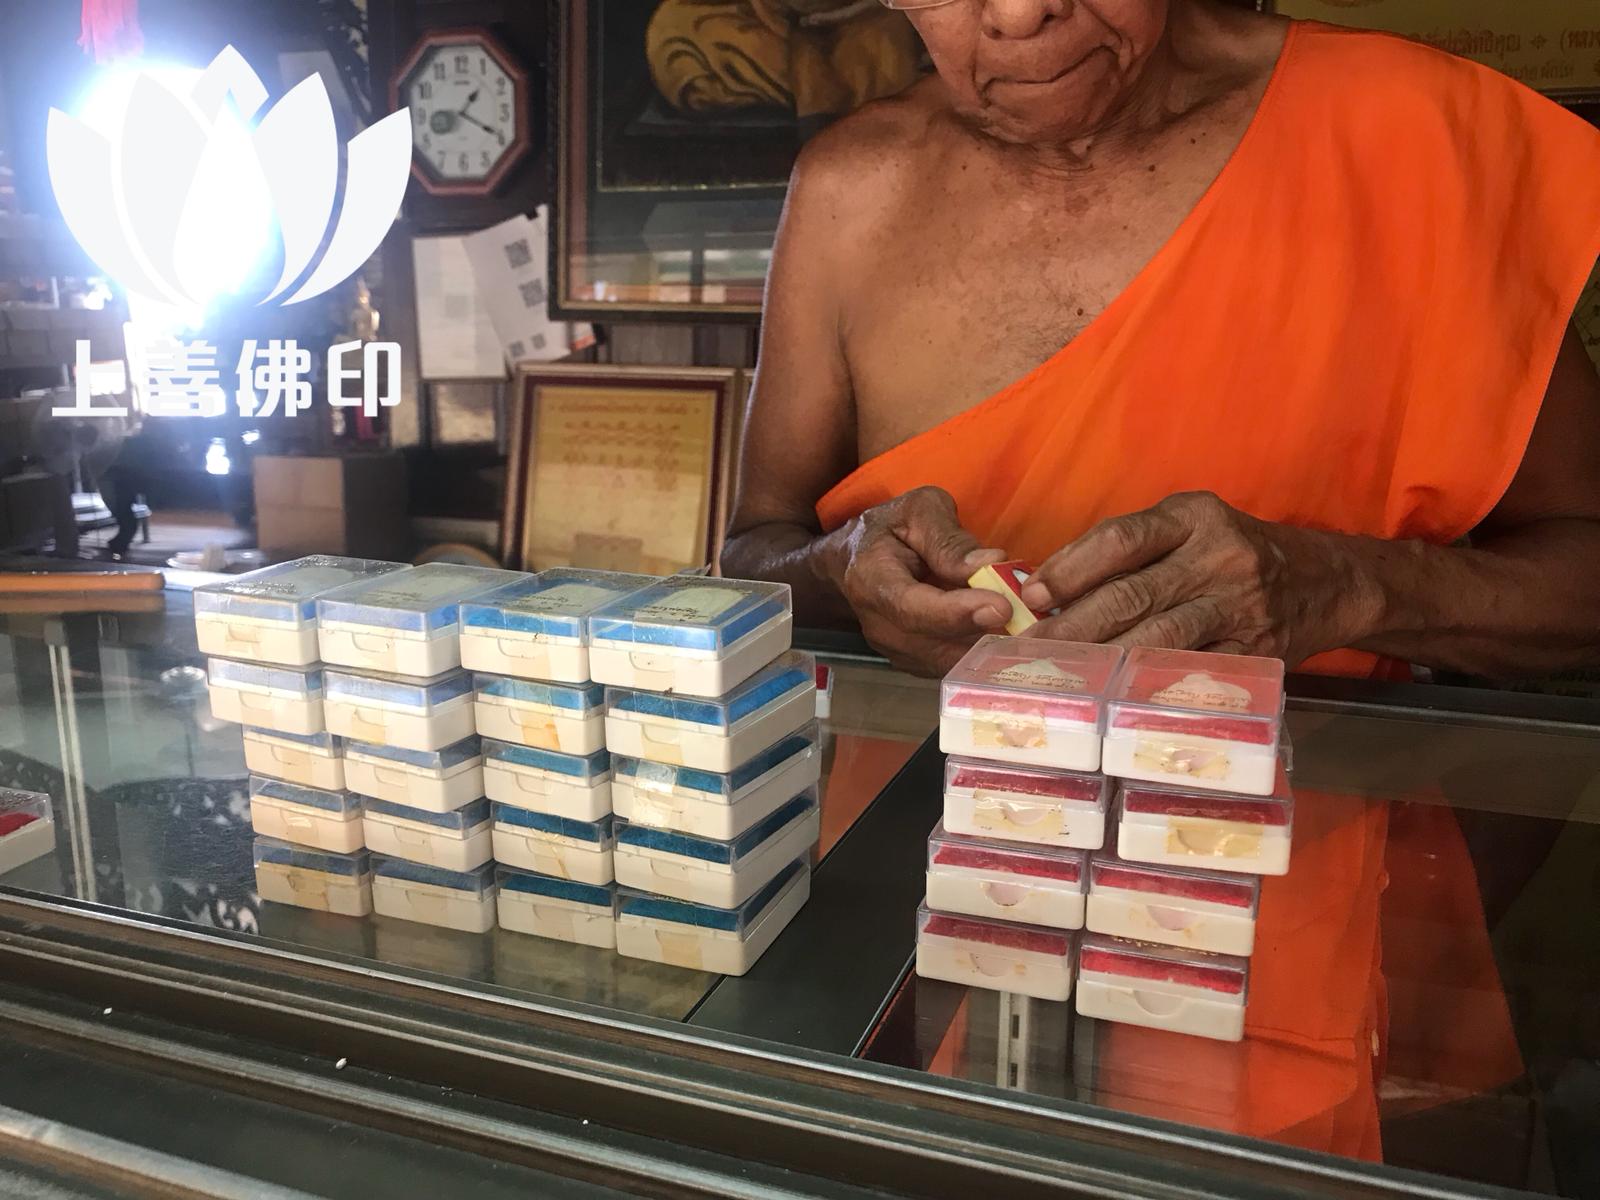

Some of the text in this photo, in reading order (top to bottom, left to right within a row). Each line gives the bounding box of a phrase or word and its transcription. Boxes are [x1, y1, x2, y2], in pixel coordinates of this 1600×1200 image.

[433, 62, 446, 81] 11
[454, 55, 469, 74] 12
[479, 58, 487, 76] 1
[419, 81, 433, 100] 10
[437, 150, 446, 170] 7
[458, 151, 469, 172] 6
